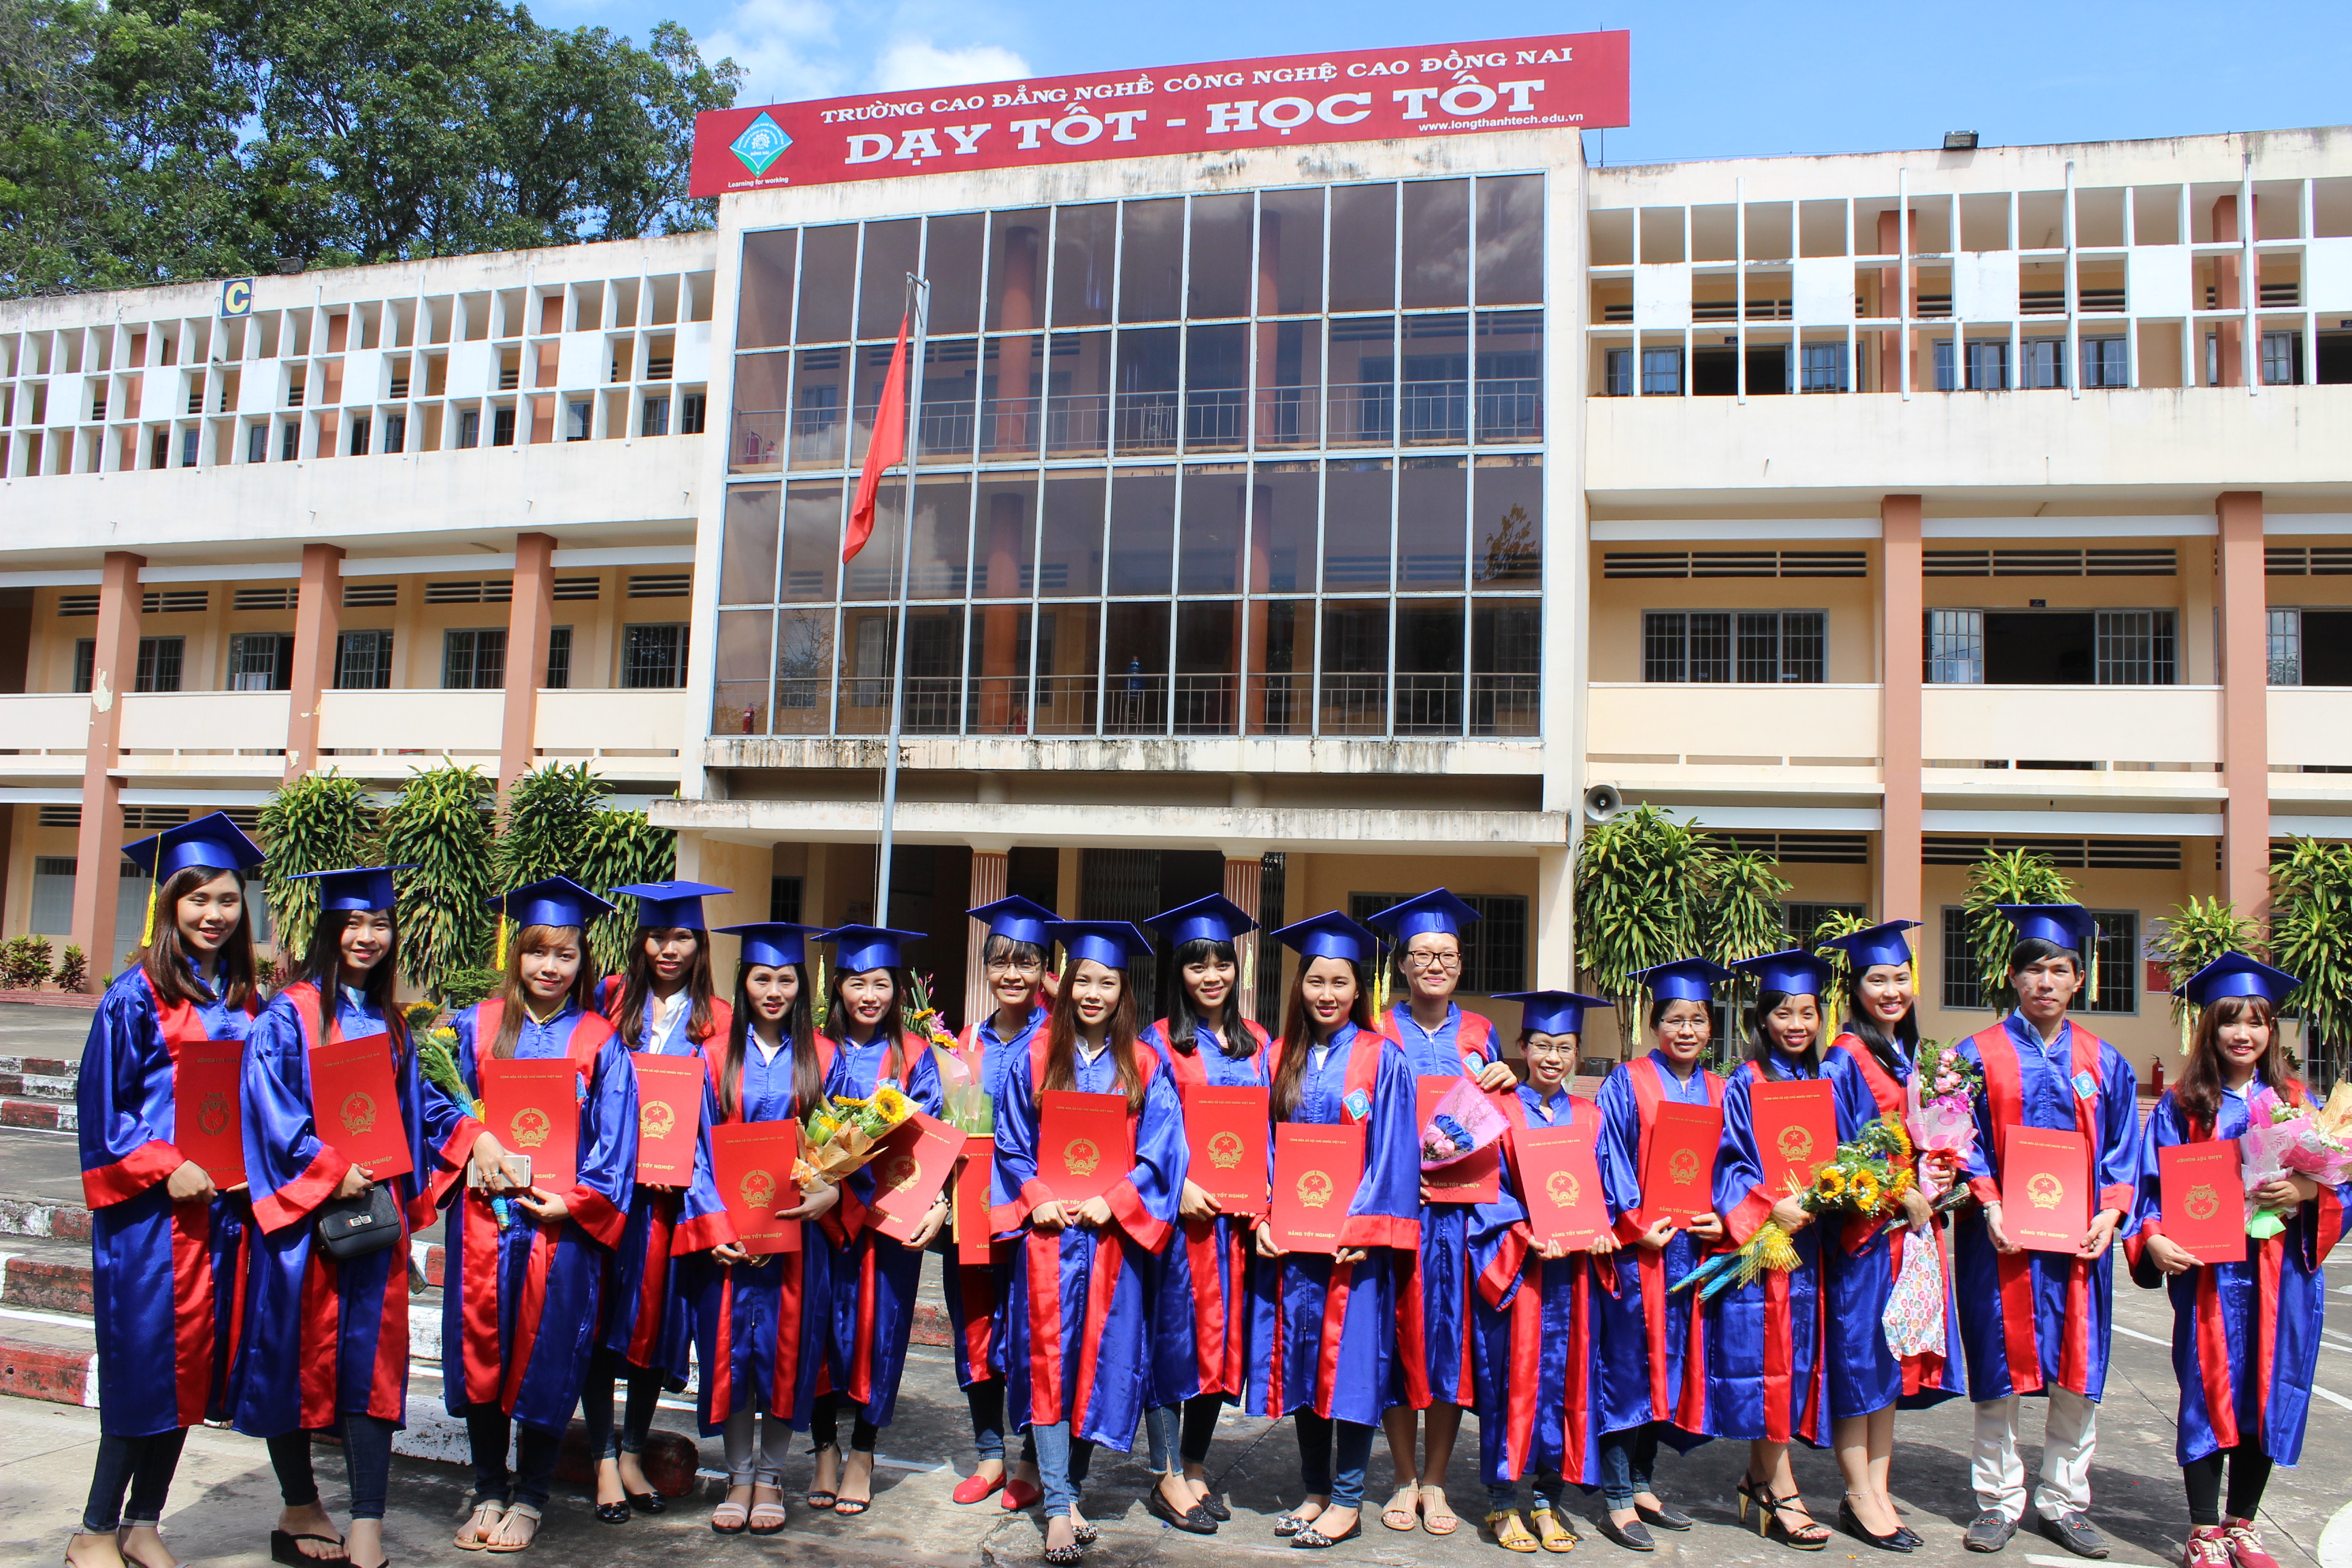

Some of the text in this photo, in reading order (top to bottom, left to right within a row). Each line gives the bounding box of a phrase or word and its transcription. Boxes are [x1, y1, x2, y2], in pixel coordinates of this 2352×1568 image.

[820, 47, 1573, 123] TRƯỜNG CAO ĐẲNG NGHỀ CÔNG NGHỆ CAO ĐỒNG NAI
[845, 69, 1545, 166] DẠY TỐT - HỌC TỐT
[1418, 113, 1584, 132] www.longthanhtech.edu.vn
[728, 180, 754, 188] Learning
[225, 281, 250, 314] C
[372, 1156, 392, 1165] NGHIỆP
